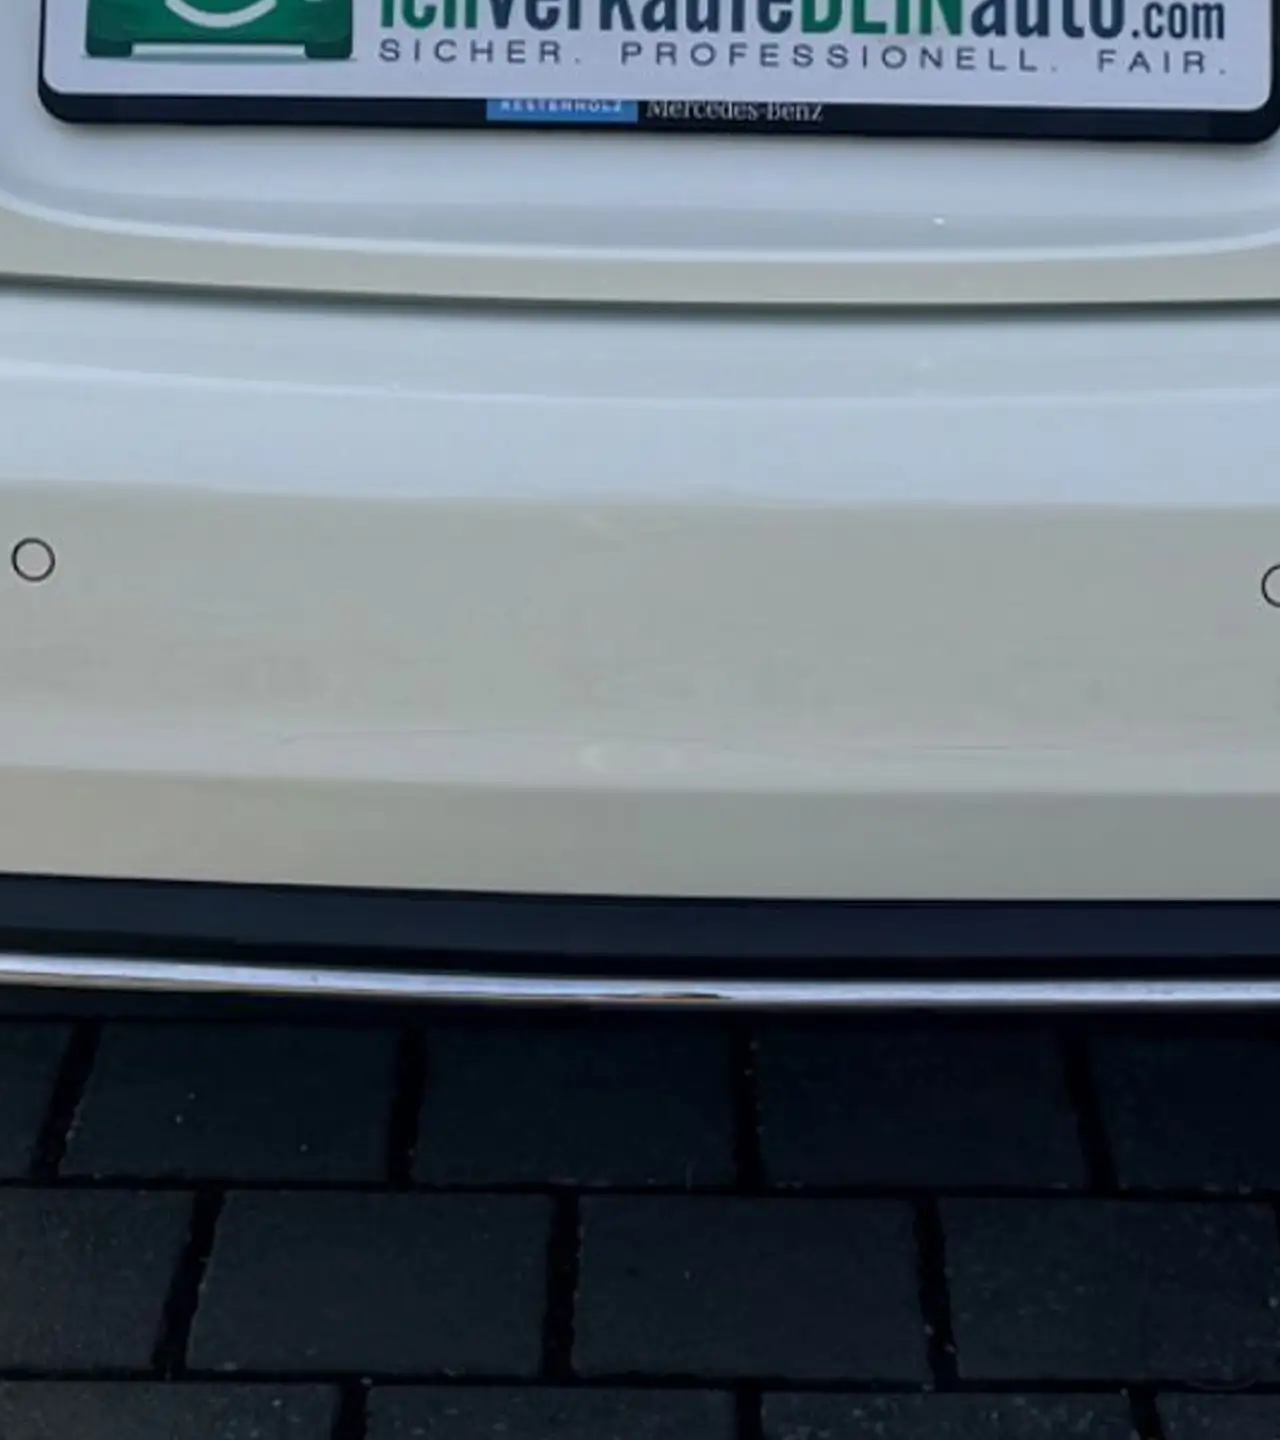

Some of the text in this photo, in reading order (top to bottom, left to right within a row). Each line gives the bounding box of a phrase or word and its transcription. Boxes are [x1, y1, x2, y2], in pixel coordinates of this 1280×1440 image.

[378, 38, 1227, 77] SICHER. PROFESSIONELL. FAIR.
[645, 99, 824, 122] Mercedes-Benz
